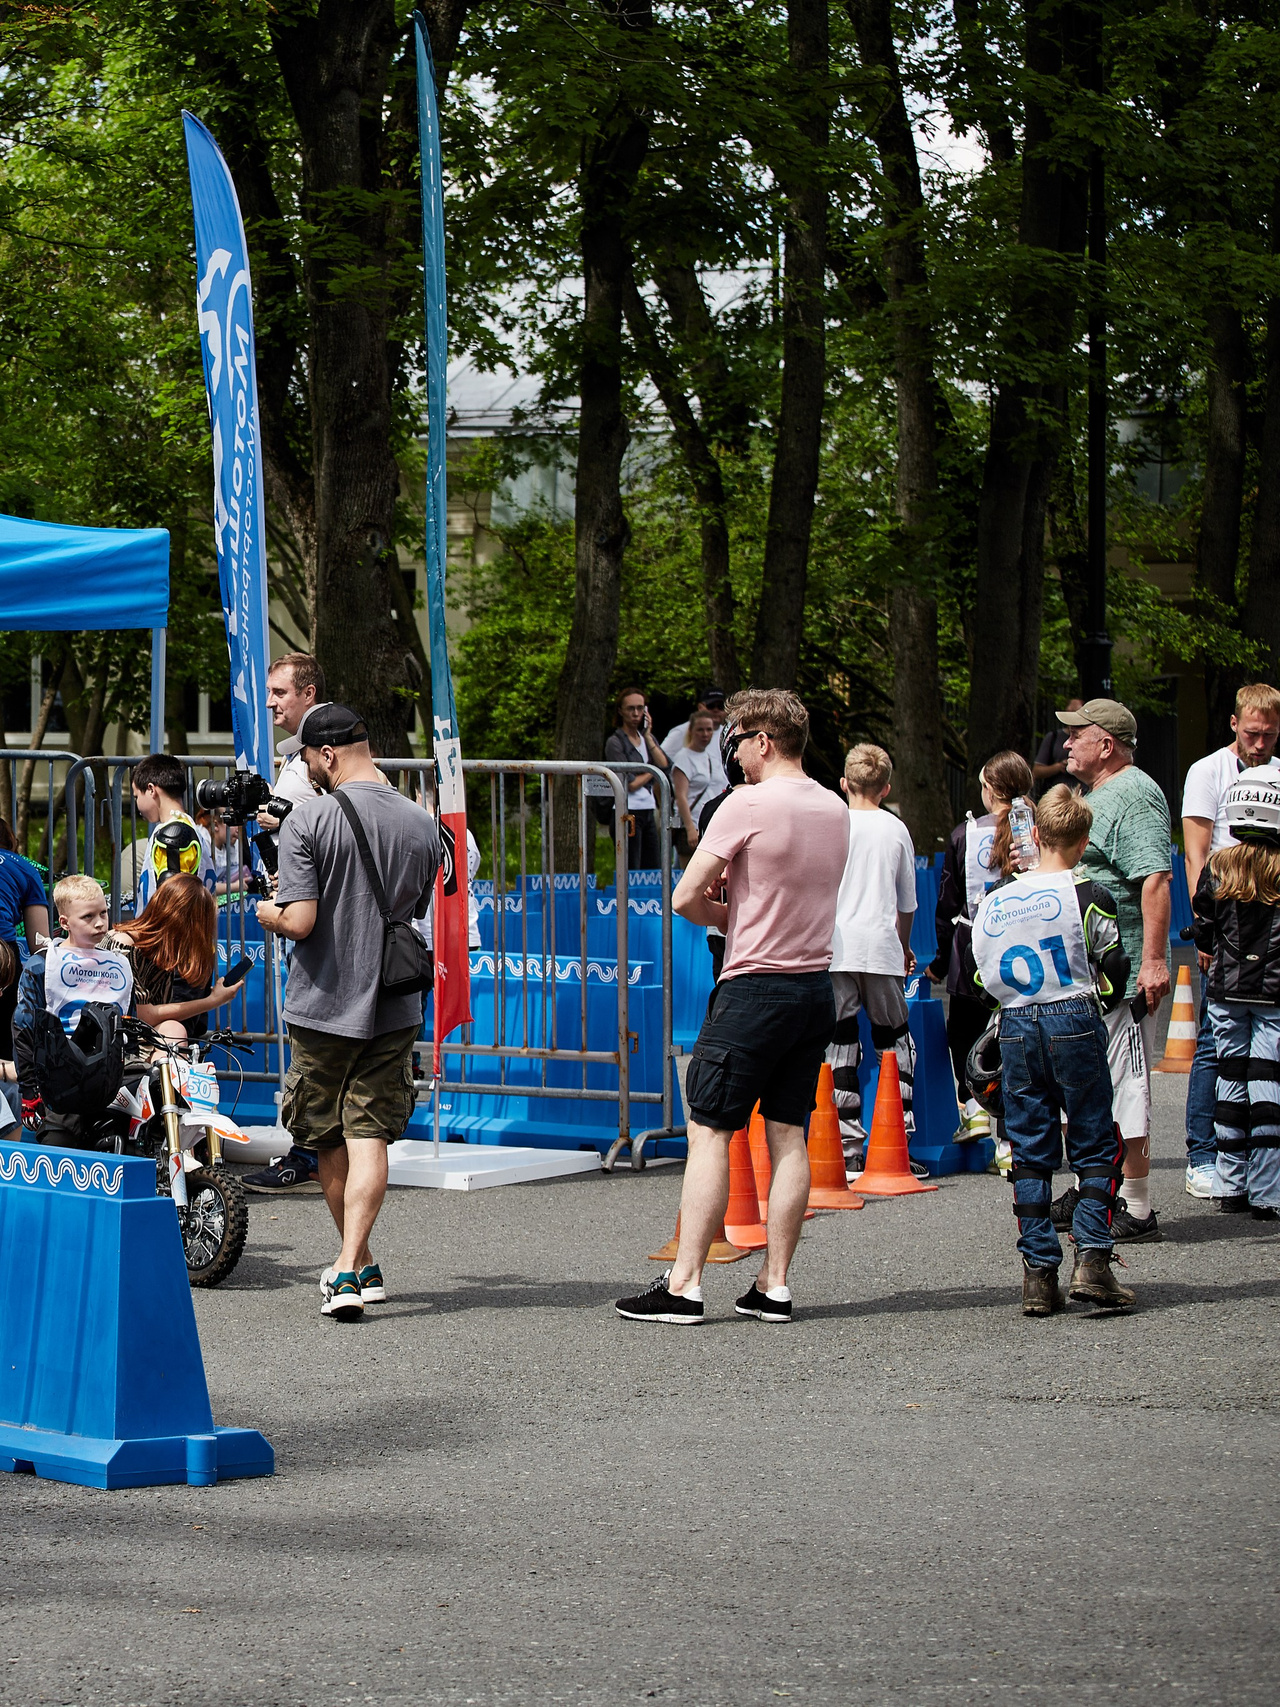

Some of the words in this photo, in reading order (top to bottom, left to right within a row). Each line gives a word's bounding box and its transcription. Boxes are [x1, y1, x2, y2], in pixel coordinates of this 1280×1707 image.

[990, 901, 1051, 925] Мотошкола
[69, 966, 119, 980] Мотошкола
[1000, 934, 1074, 997] 01
[186, 1076, 212, 1099] 50
